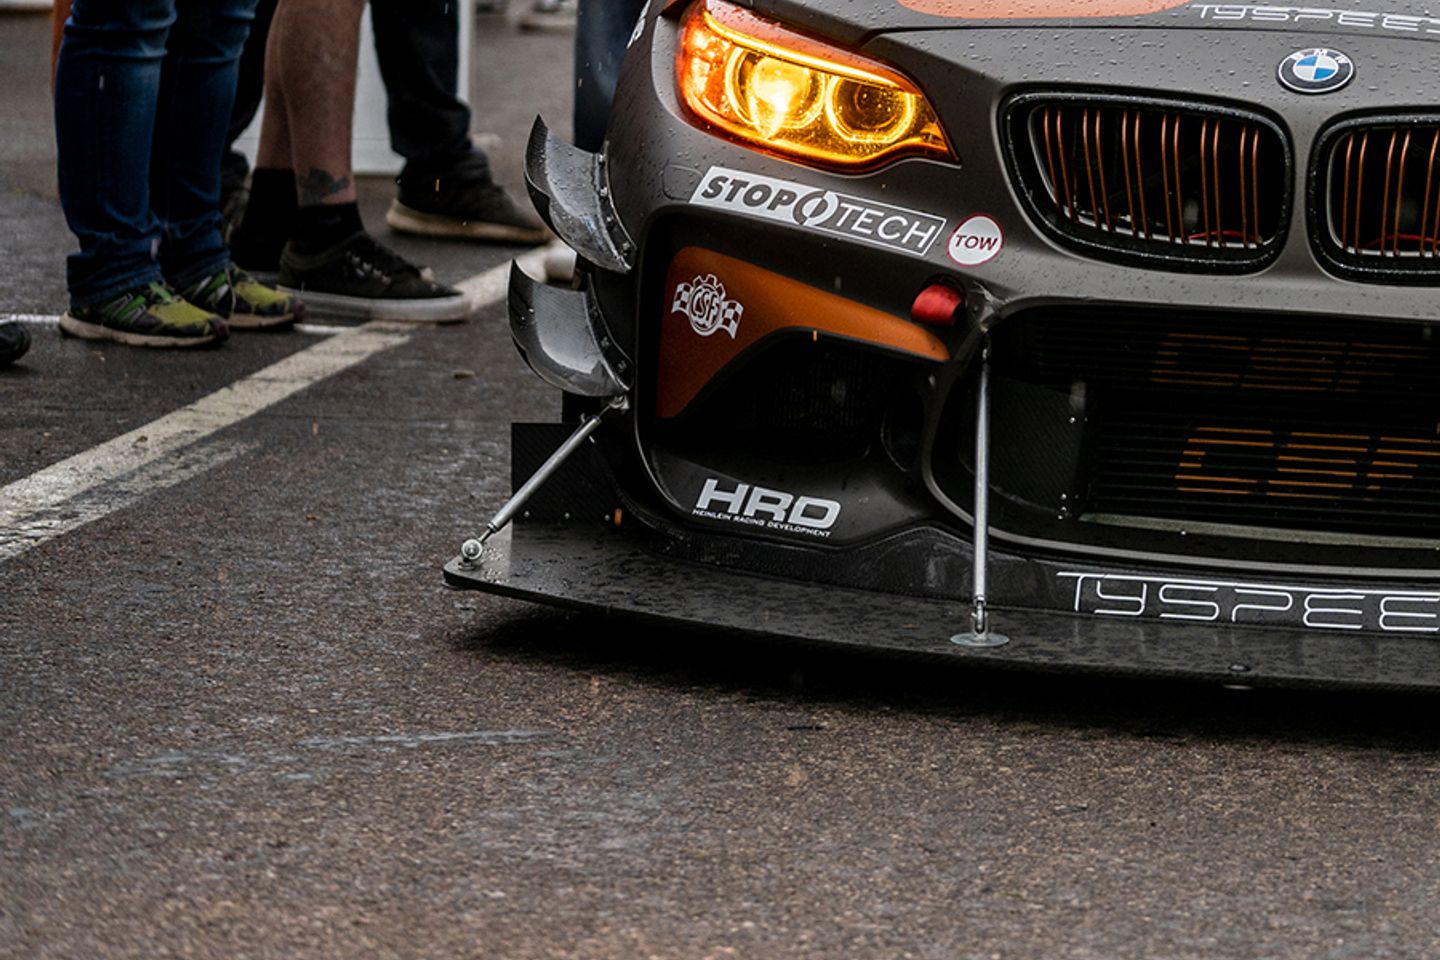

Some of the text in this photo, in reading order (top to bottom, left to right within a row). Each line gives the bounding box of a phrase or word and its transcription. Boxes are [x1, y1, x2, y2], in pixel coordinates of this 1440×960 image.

[953, 233, 999, 252] TOW
[695, 478, 842, 530] HRD
[692, 508, 832, 538] HEINLEIN RACING DEVELOPMENT
